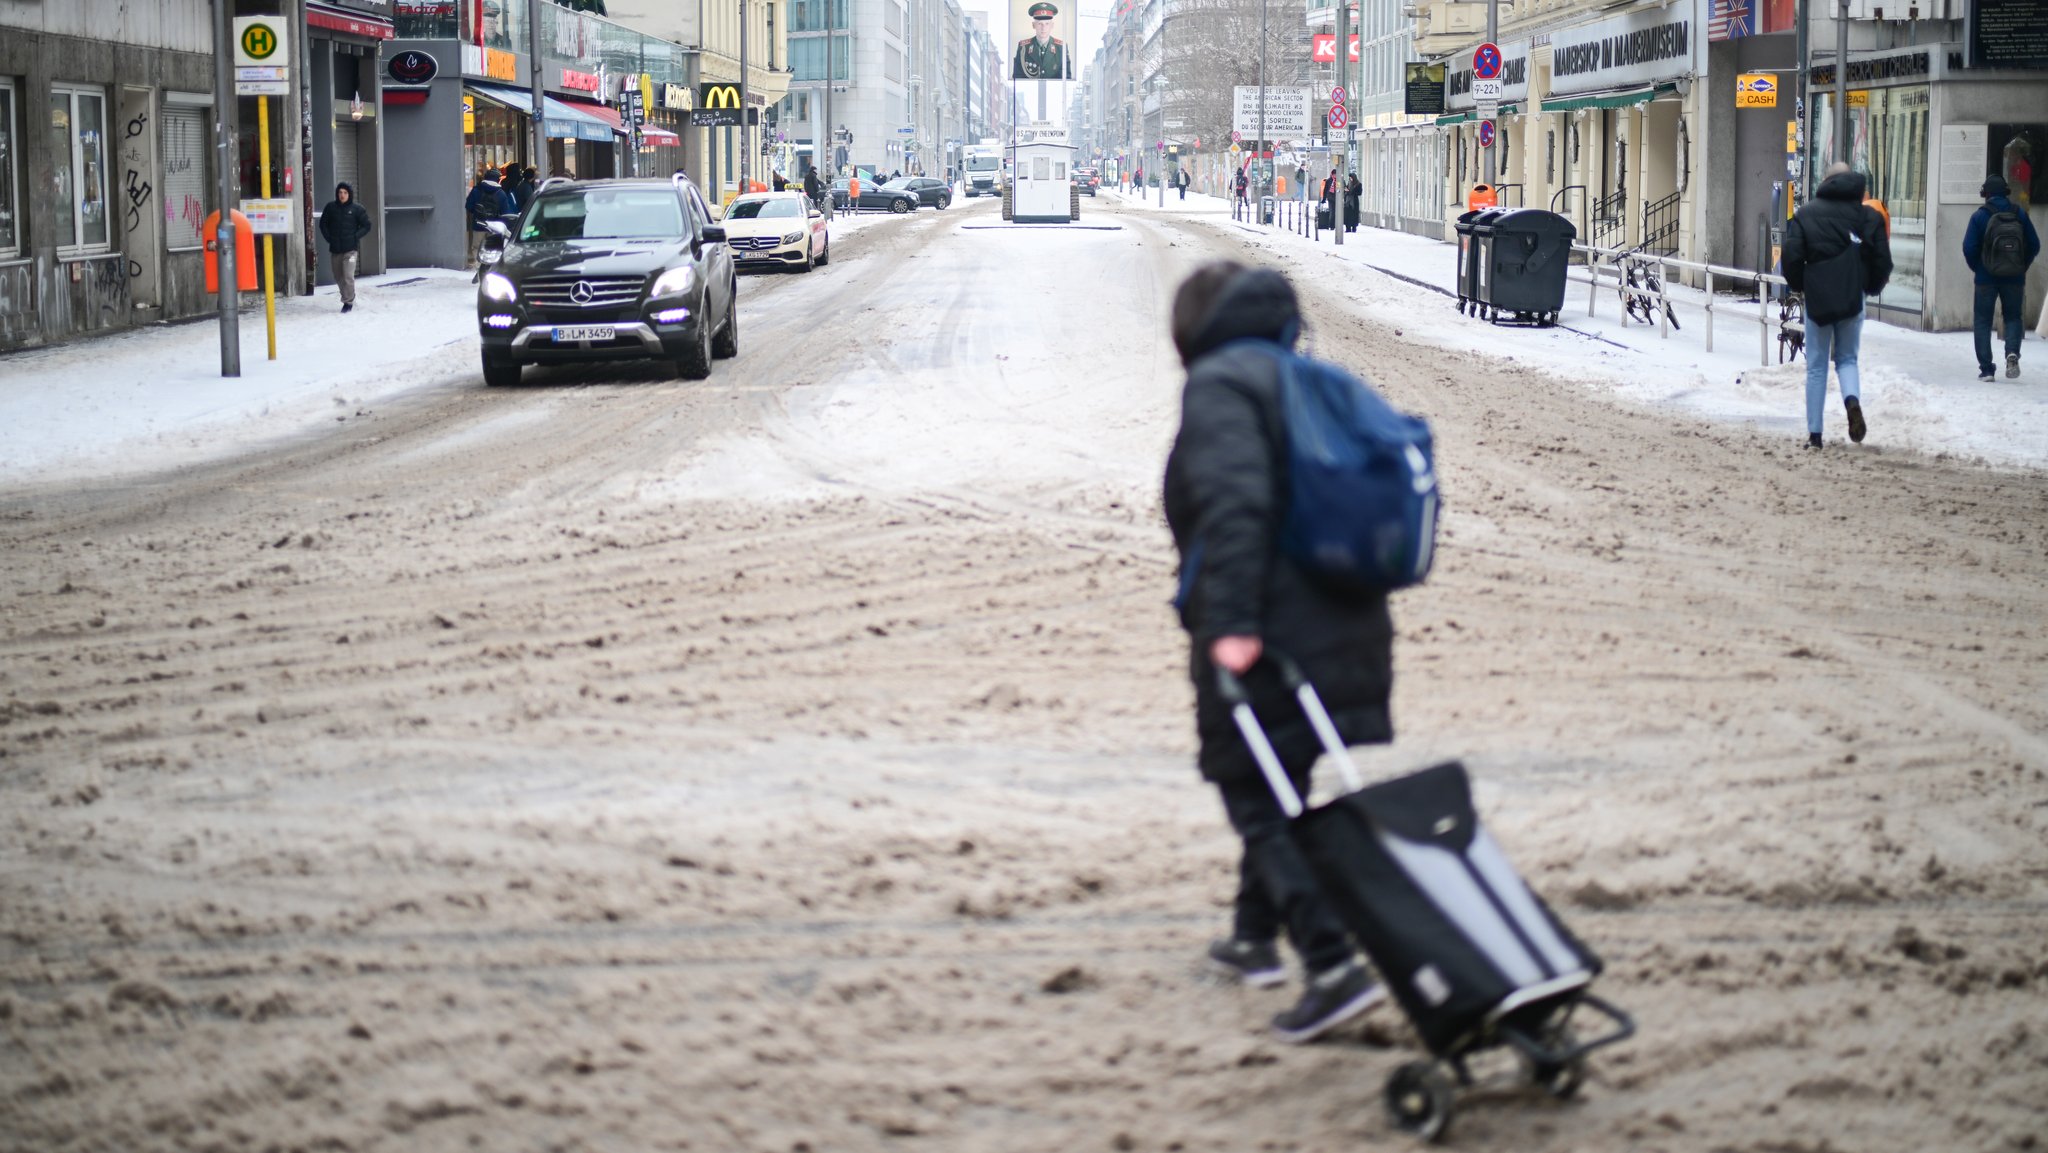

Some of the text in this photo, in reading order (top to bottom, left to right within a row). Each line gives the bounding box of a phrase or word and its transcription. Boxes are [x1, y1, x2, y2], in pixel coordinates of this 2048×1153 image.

[1317, 41, 1359, 56] KC
[1554, 20, 1688, 76] MAUERSHOP IM MAUERMUSEUM
[1846, 57, 1887, 82] HECKPOINT
[1747, 96, 1774, 104] CASH
[558, 327, 613, 339] B LM 3459
